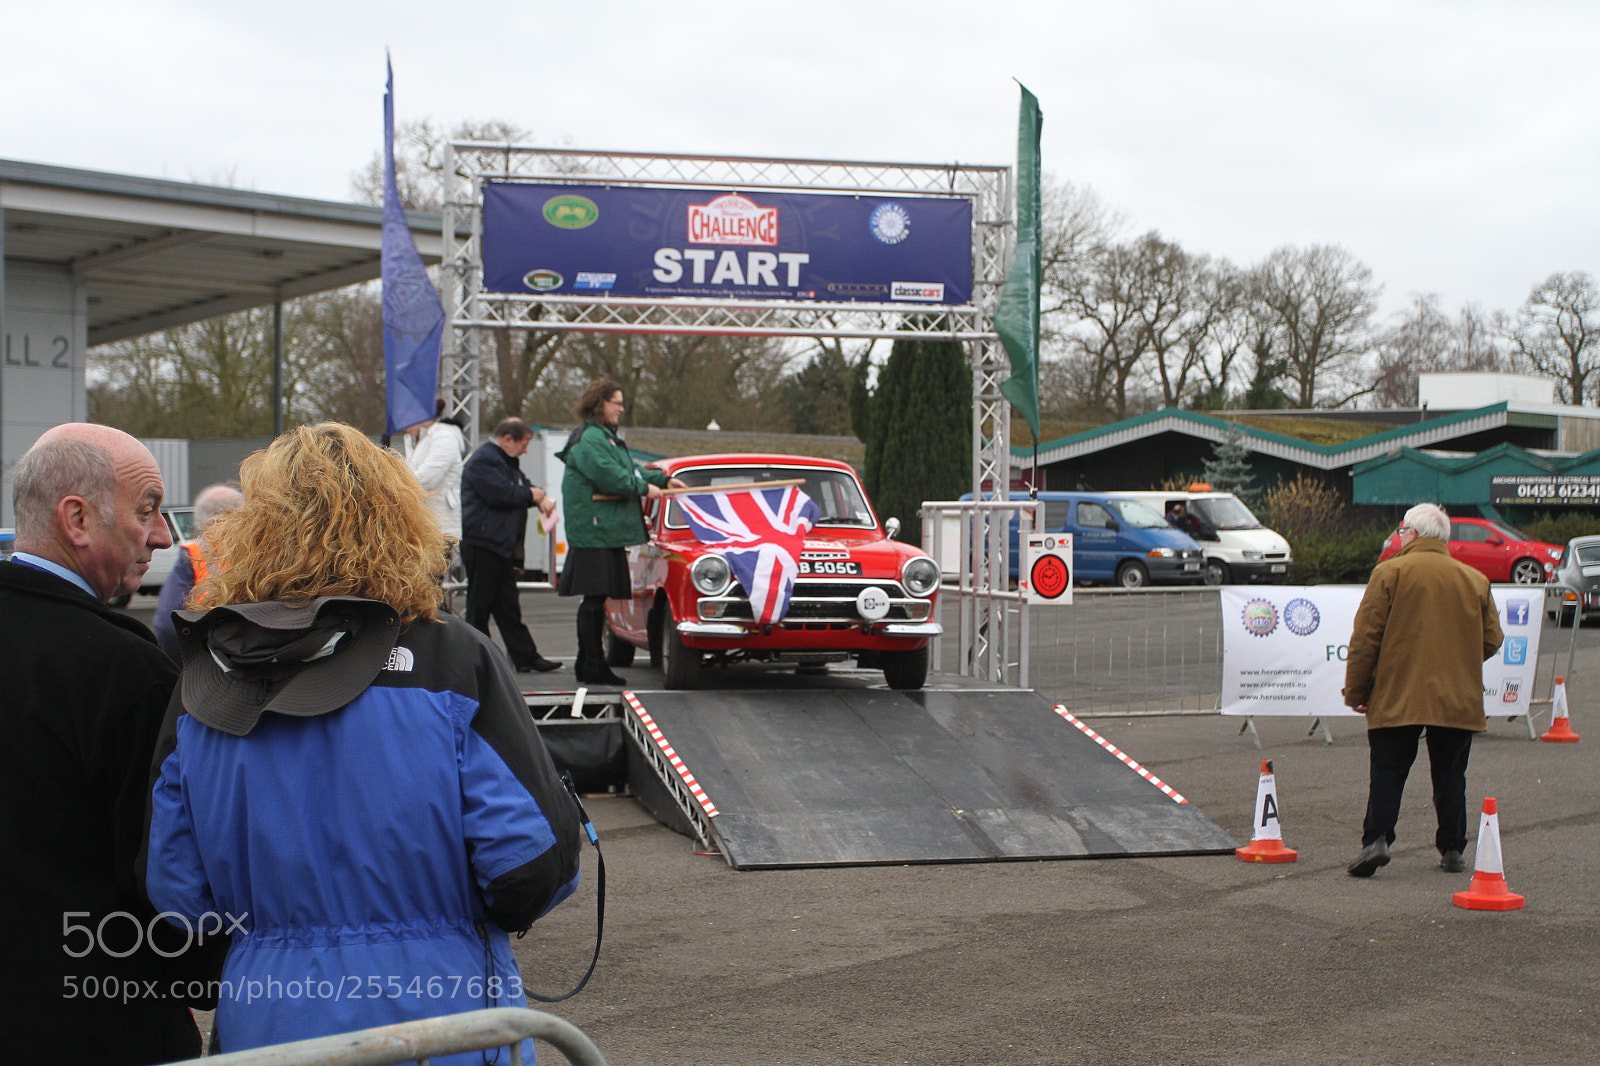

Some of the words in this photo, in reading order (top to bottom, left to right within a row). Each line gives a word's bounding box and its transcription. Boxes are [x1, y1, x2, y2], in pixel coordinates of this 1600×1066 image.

[692, 209, 775, 243] CHALLENGE
[652, 247, 810, 288] START
[6, 332, 41, 367] LL
[52, 334, 70, 368] 2
[1517, 484, 1556, 498] 01455
[799, 561, 811, 574] B
[814, 561, 858, 575] 505C
[1326, 645, 1349, 661] FO
[1506, 681, 1519, 692] You
[1262, 794, 1280, 827] A
